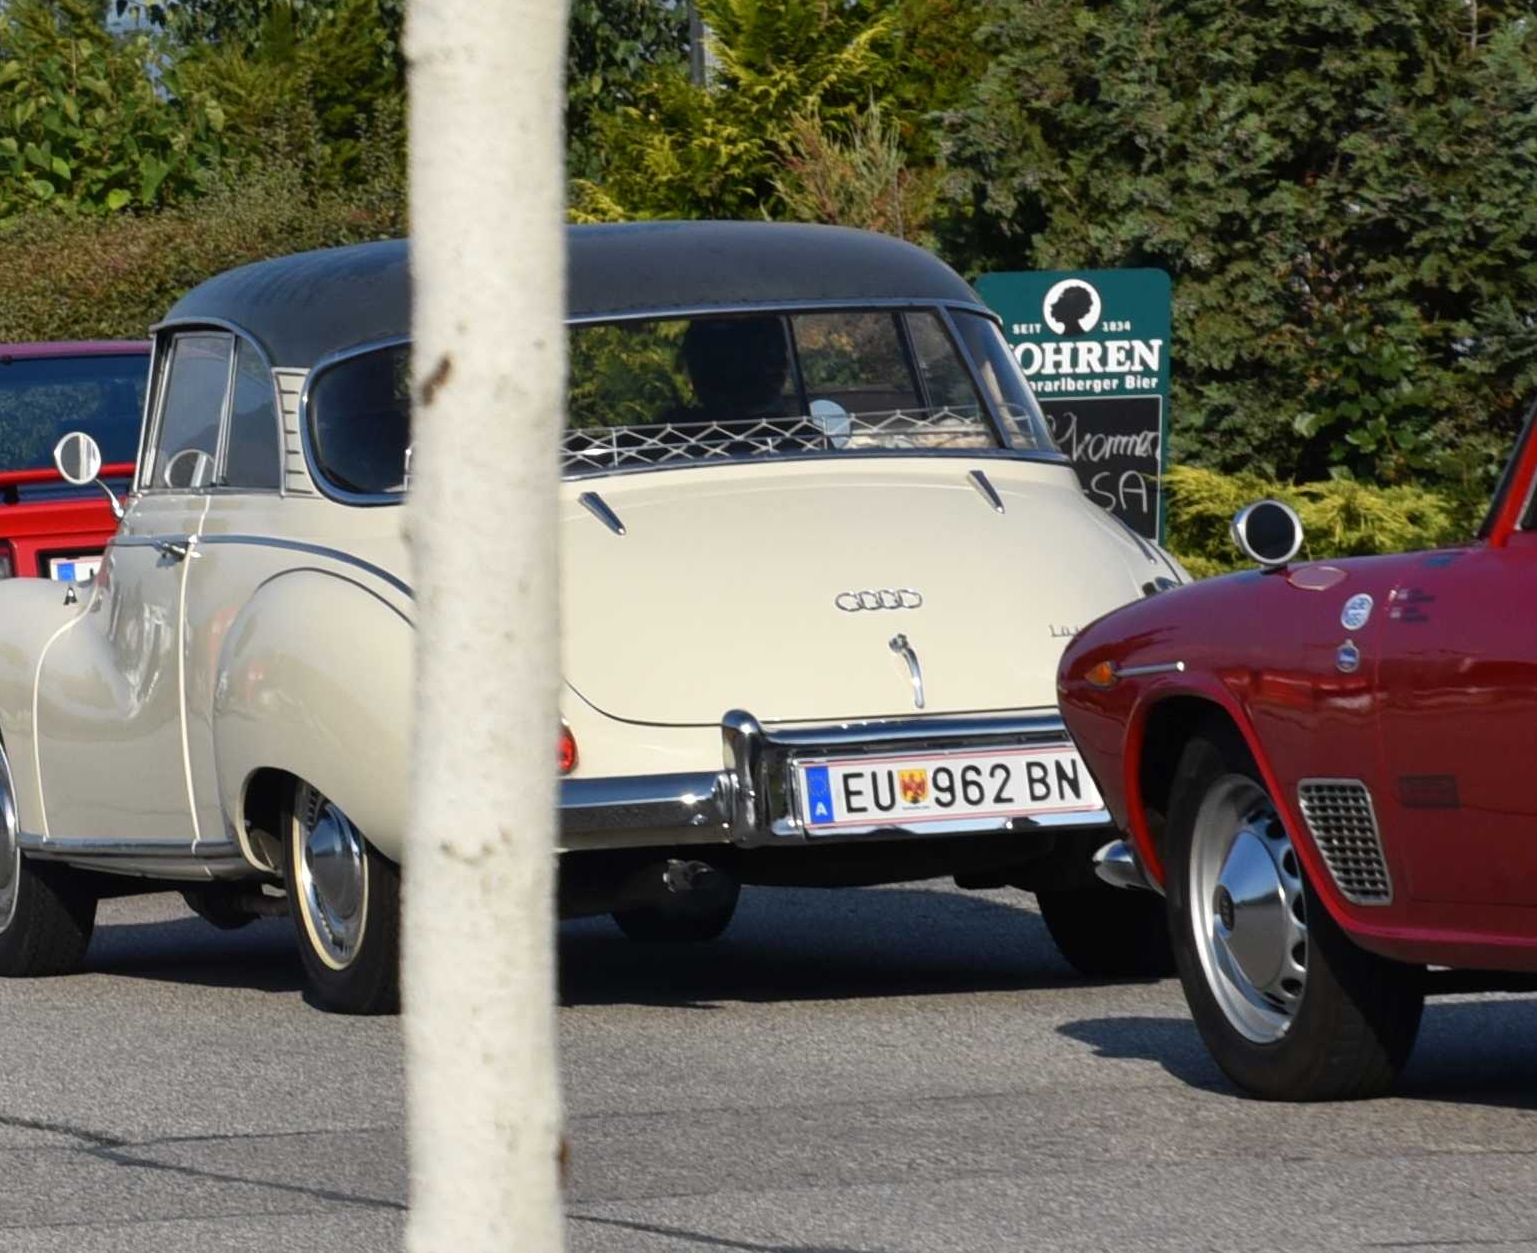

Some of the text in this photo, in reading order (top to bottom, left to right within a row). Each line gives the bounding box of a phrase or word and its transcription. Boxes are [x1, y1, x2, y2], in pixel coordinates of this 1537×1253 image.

[1012, 323, 1042, 335] SEIT
[1011, 338, 1163, 376] OHREN
[1124, 375, 1159, 389] Bier
[842, 758, 1082, 814] EU 962 BN
